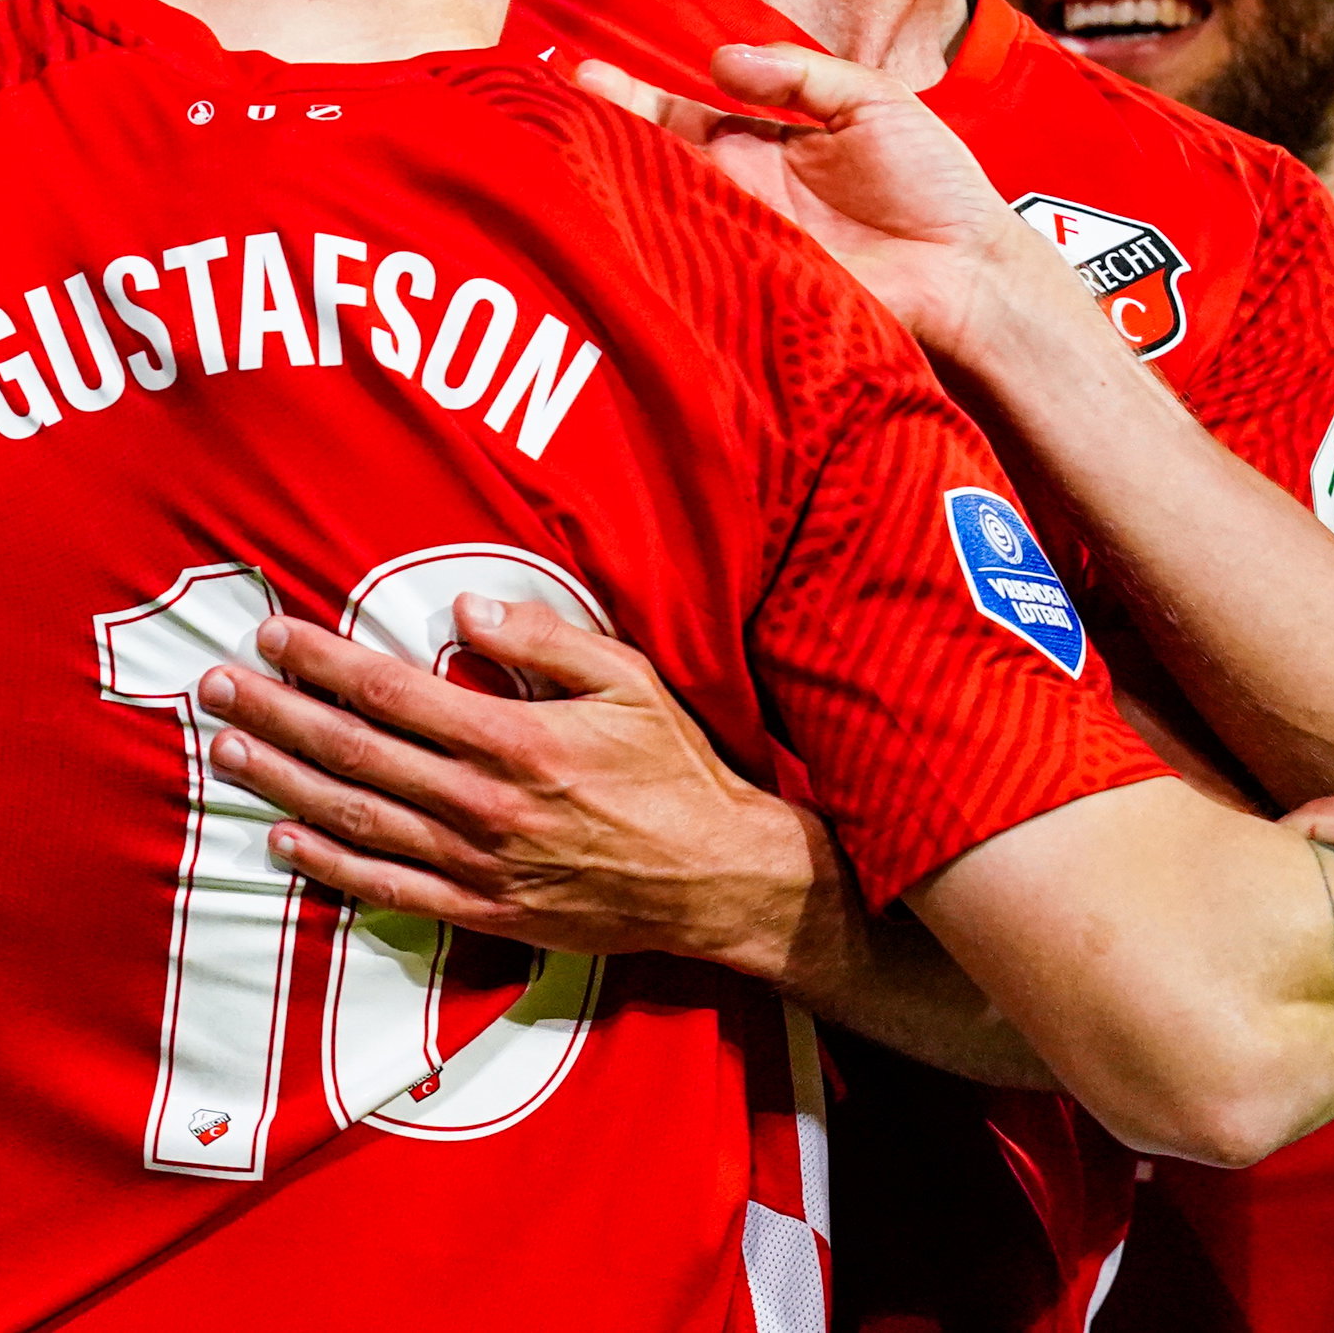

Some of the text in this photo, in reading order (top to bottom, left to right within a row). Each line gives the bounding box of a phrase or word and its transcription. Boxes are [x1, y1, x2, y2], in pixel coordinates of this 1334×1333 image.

[1053, 213, 1080, 245] F
[1078, 235, 1167, 297] RECHT
[1110, 297, 1147, 343] C
[987, 578, 1069, 609] VRIENDEN
[1011, 602, 1073, 631] LOTERIJ
